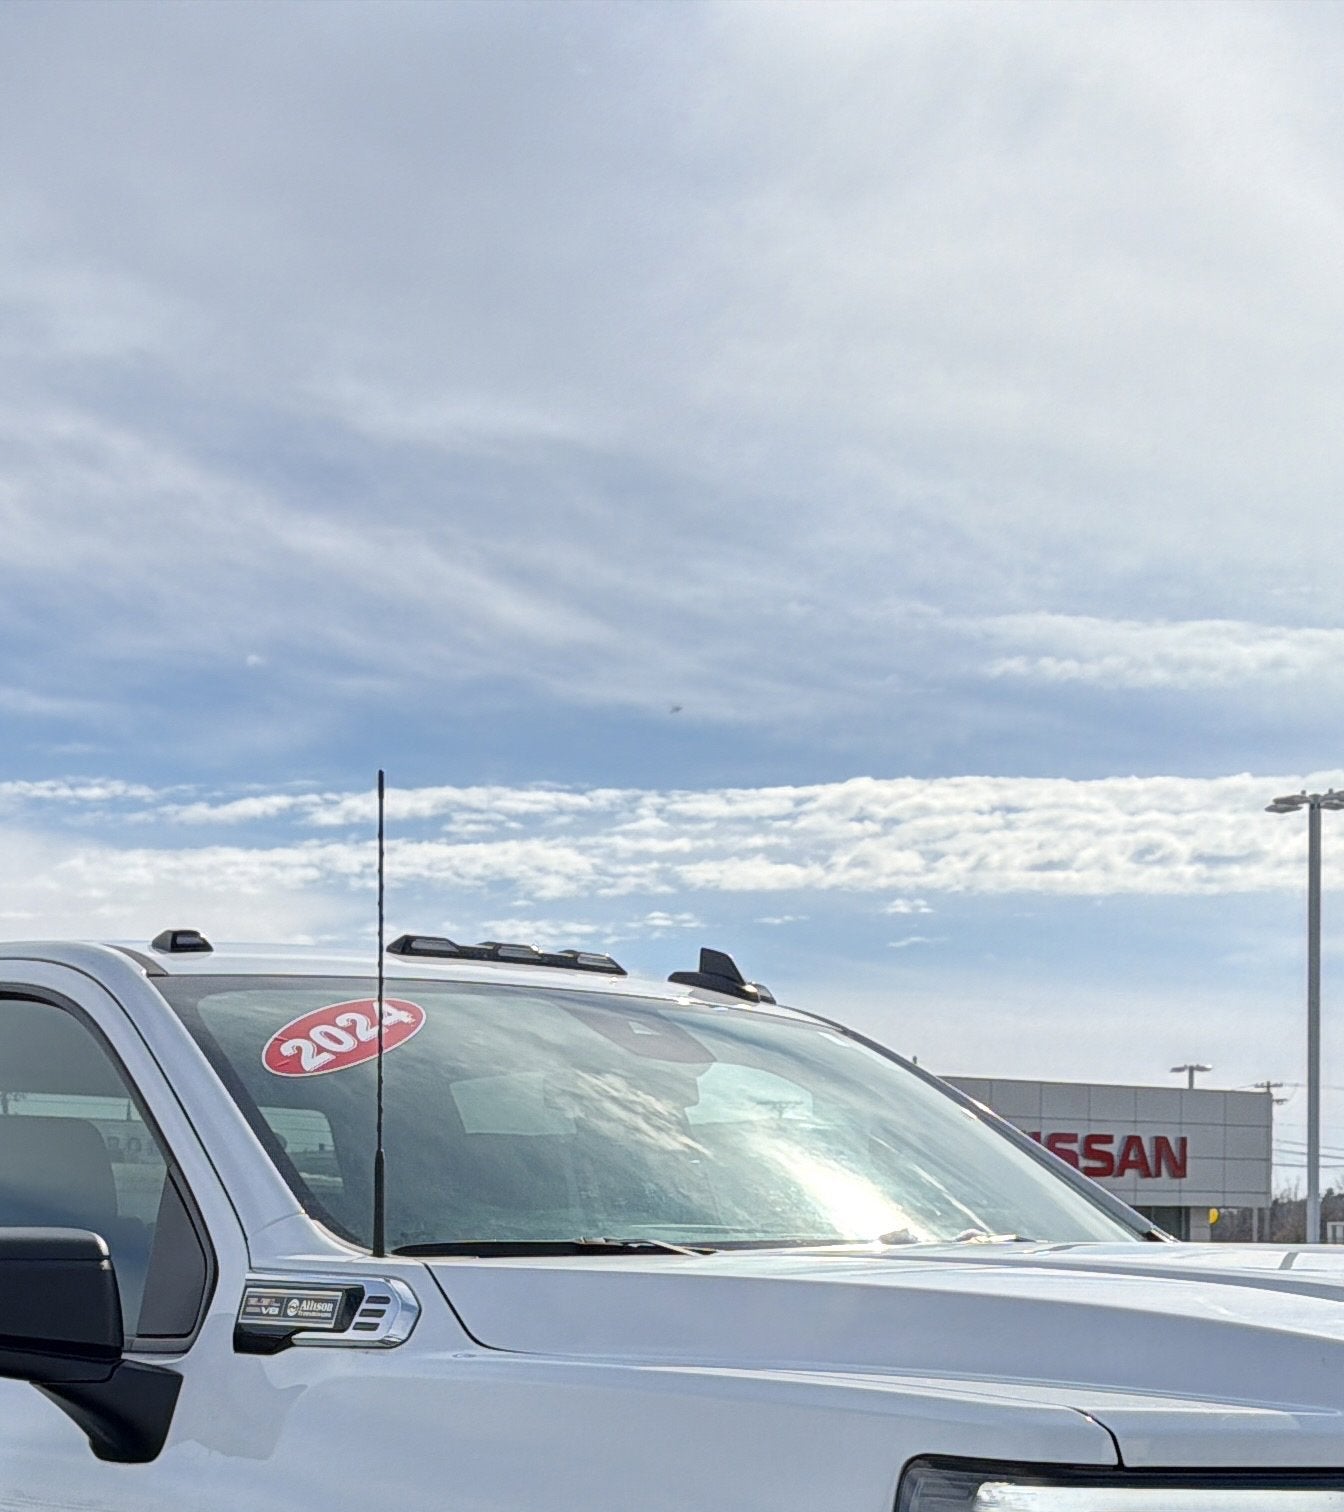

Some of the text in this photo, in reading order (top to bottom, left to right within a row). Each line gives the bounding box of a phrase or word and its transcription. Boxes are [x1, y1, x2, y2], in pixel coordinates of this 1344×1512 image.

[279, 1000, 417, 1072] 2024
[1028, 1131, 1188, 1179] SSAN
[299, 1299, 334, 1312] Allison
